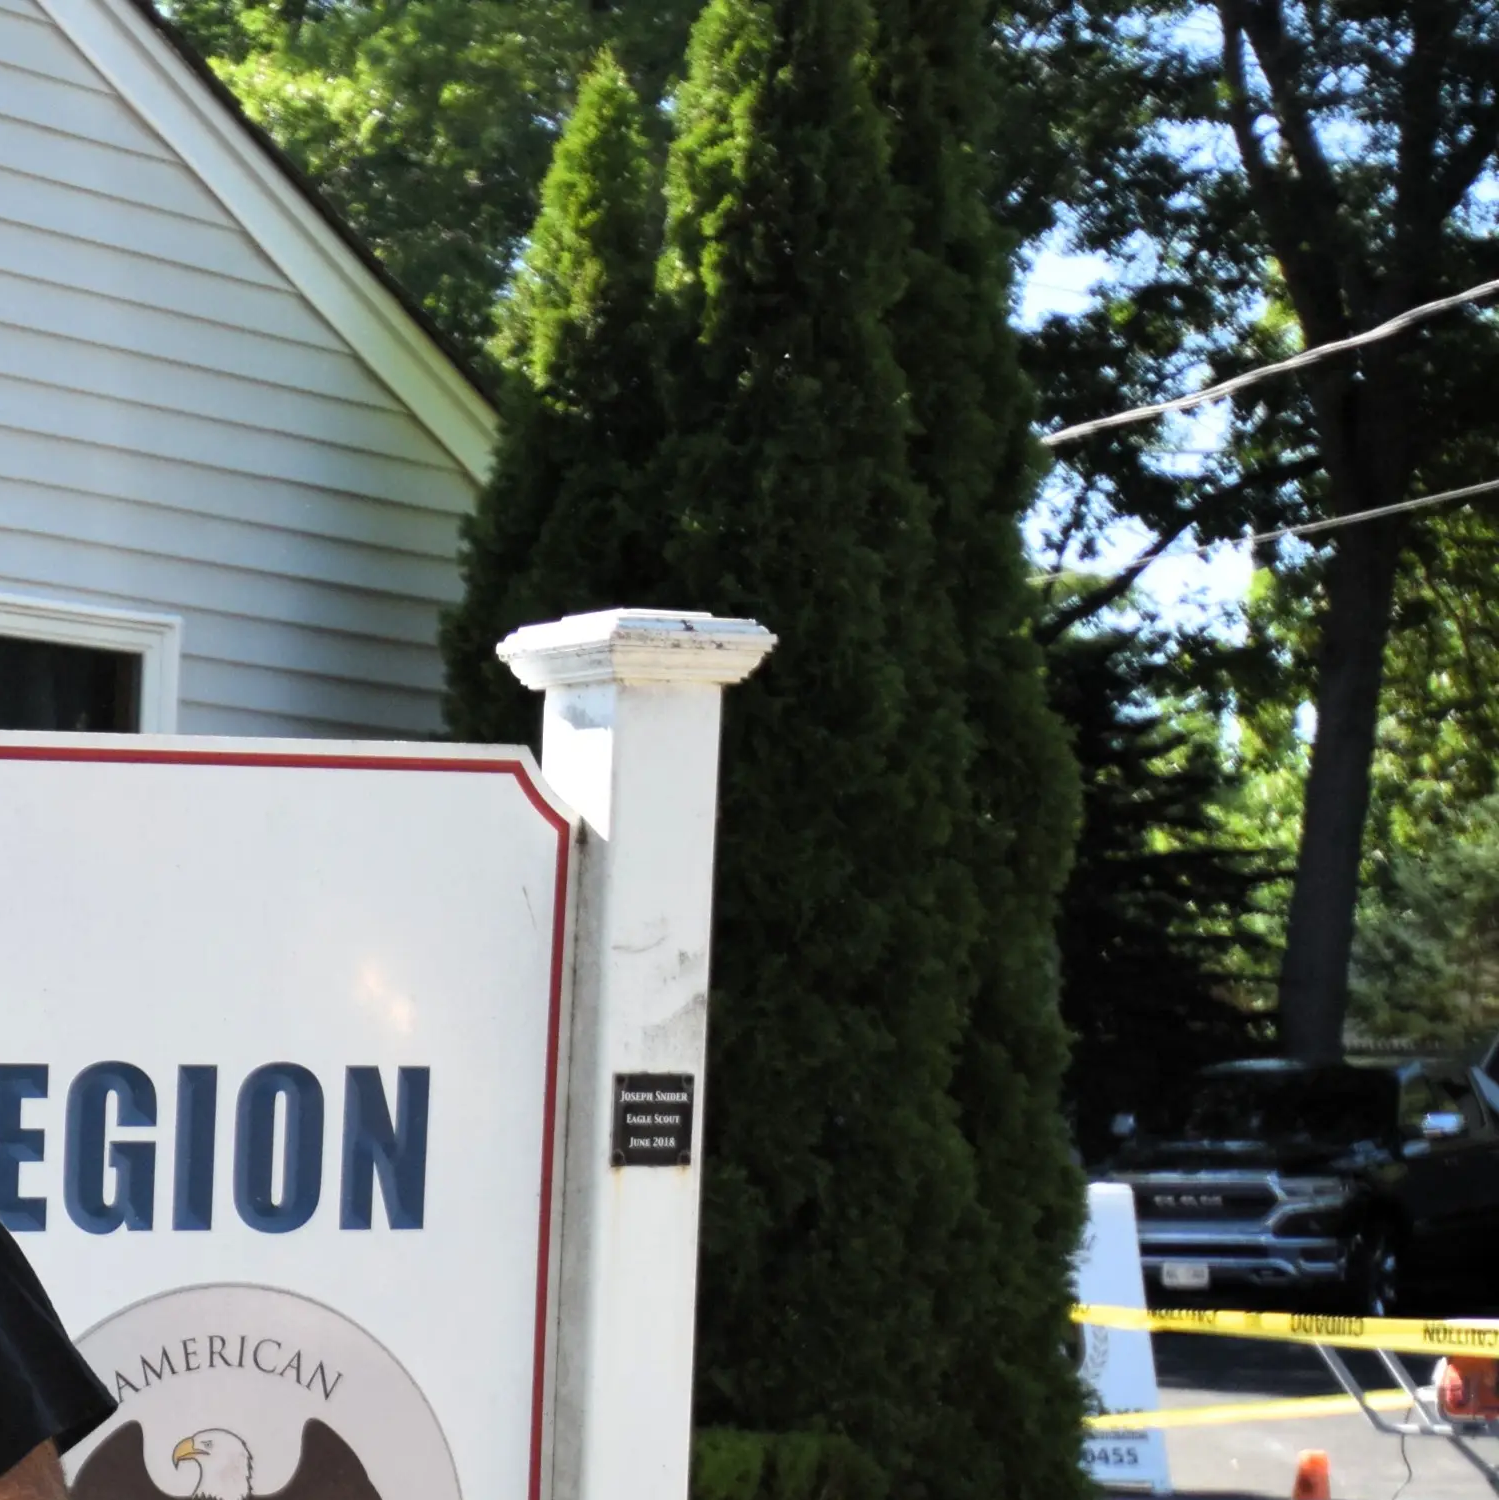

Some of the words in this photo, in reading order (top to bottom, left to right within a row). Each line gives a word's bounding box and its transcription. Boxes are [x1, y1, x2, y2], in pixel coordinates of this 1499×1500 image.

[621, 1090, 653, 1102] JOSEPH
[626, 1113, 653, 1125] EAGLE
[654, 1113, 681, 1125] SCOUT
[629, 1137, 651, 1148] JUNE
[652, 1136, 676, 1148] 2018
[114, 1334, 344, 1404] AMERICAN
